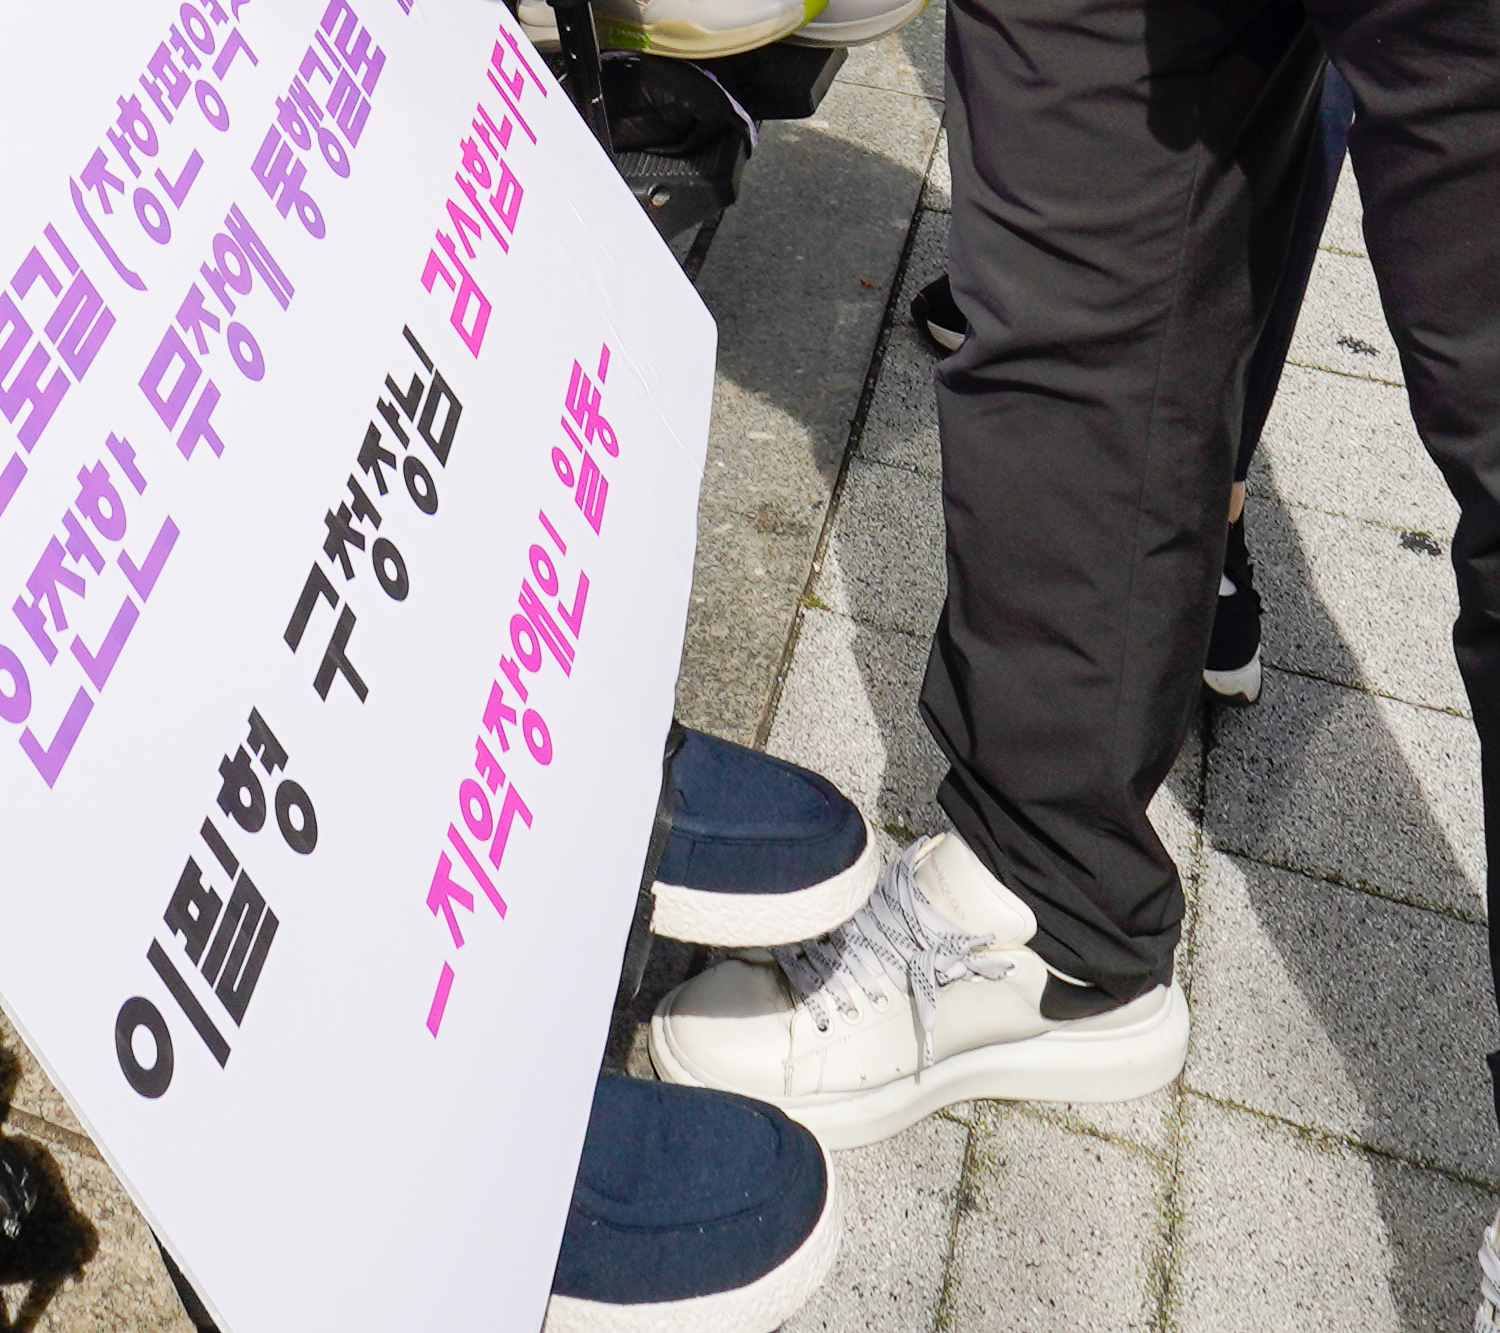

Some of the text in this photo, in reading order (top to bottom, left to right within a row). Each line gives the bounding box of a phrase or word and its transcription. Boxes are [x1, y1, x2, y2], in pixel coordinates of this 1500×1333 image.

[116, 27, 547, 1097] 이필형 구청장님 감사합니다
[139, 204, 294, 459] 무장애
